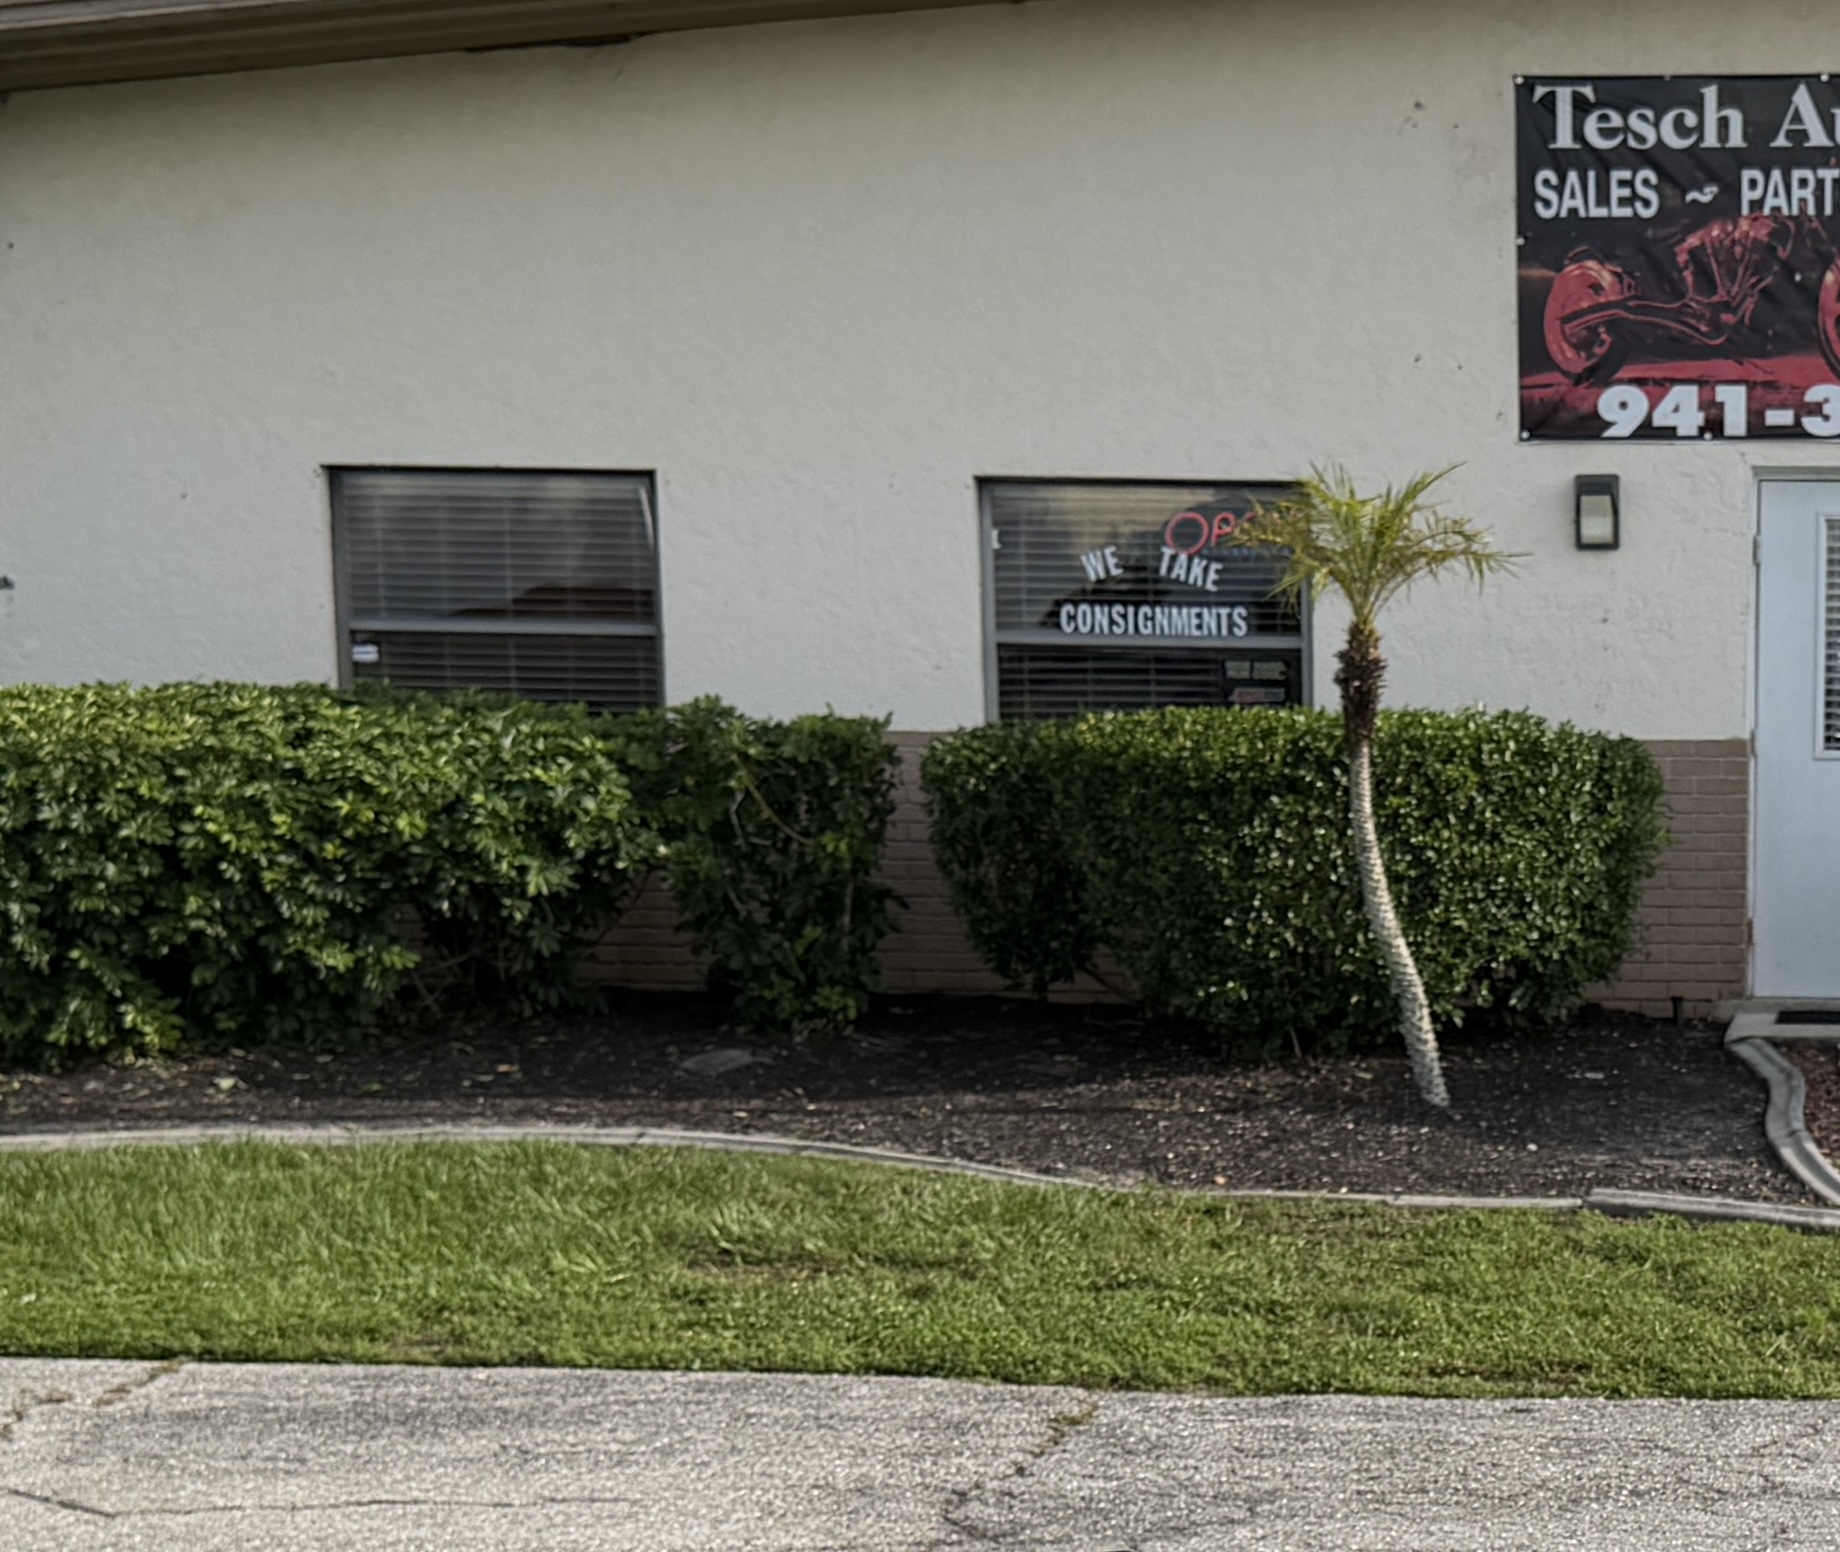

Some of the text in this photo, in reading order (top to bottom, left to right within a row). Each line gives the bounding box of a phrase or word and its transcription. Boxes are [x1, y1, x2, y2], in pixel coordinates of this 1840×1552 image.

[1534, 84, 1748, 150] Tesch
[1534, 168, 1660, 219] SALES
[1080, 545, 1225, 593] WE TAKE
[1059, 602, 1249, 637] CONSIGNMENTS
